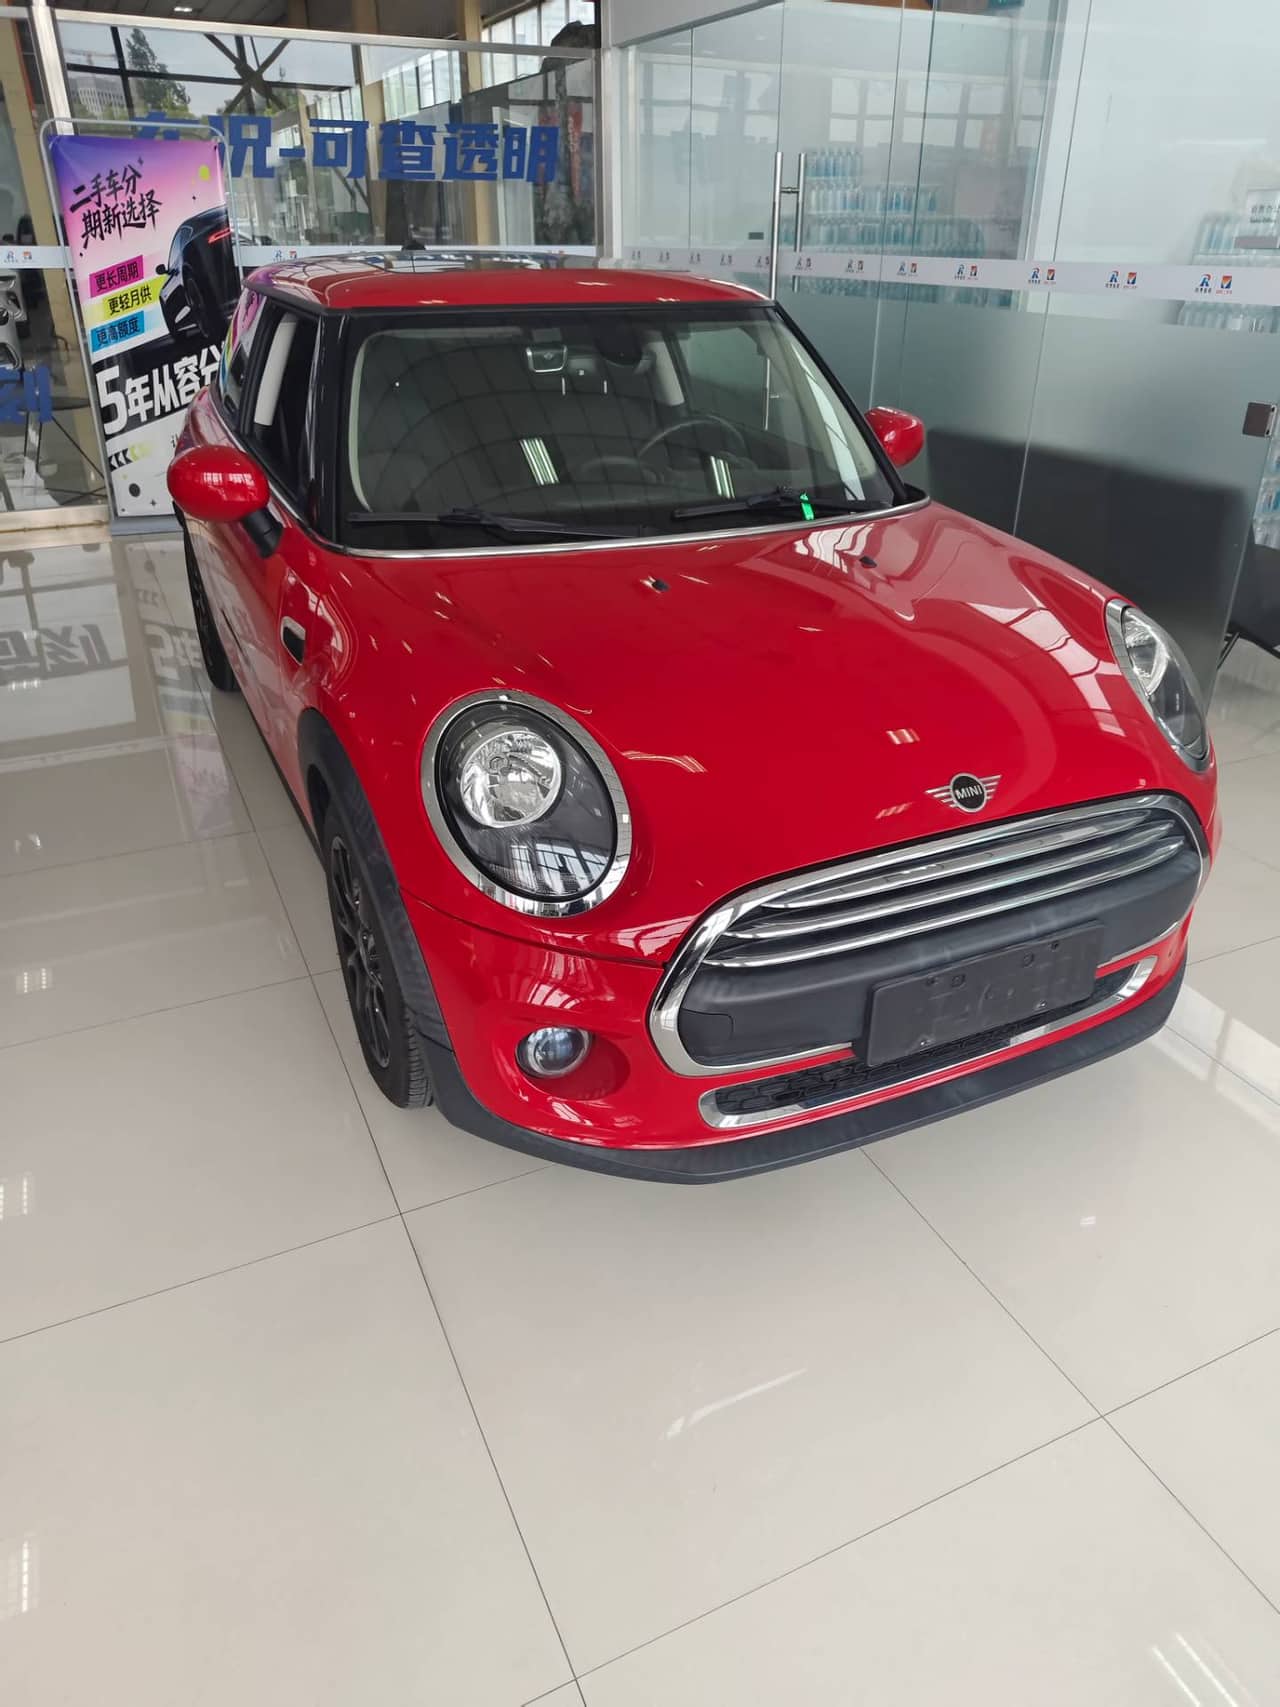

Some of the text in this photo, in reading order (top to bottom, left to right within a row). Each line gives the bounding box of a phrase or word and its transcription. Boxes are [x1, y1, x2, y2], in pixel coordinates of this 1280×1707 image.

[69, 164, 143, 213] 二手车分
[81, 190, 162, 249] 期新选择
[95, 261, 139, 292] 更长周期
[108, 285, 152, 316] 更轻月供
[96, 317, 140, 346] 更高额度
[96, 341, 224, 436] 5年从容分
[955, 785, 983, 799] MINI
